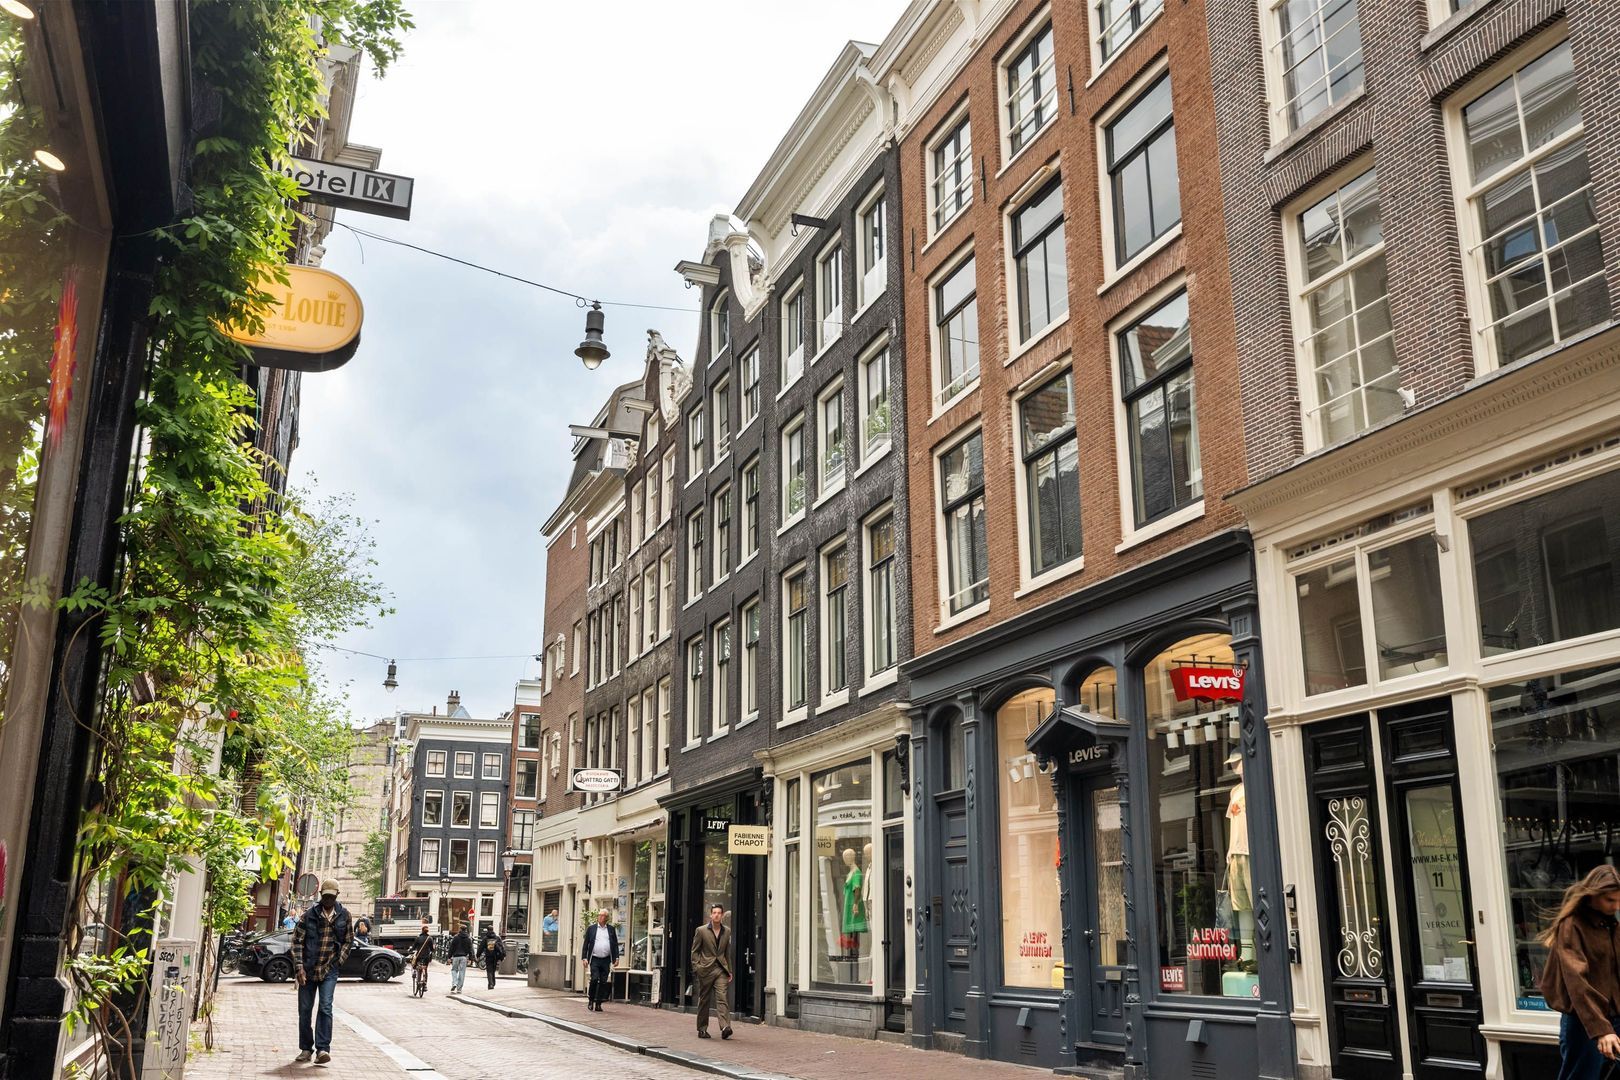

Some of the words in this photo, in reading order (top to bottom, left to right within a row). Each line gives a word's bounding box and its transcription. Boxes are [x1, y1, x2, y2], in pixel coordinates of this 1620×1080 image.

[366, 177, 392, 200] IX
[734, 832, 765, 840] FABIENNE
[734, 839, 765, 847] CHAPOT
[1432, 872, 1444, 887] 11
[1426, 919, 1461, 929] VERSACE
[1192, 928, 1201, 943] A
[1201, 927, 1230, 943] LEVI'S
[1020, 945, 1052, 958] summer
[1187, 943, 1237, 960] summer
